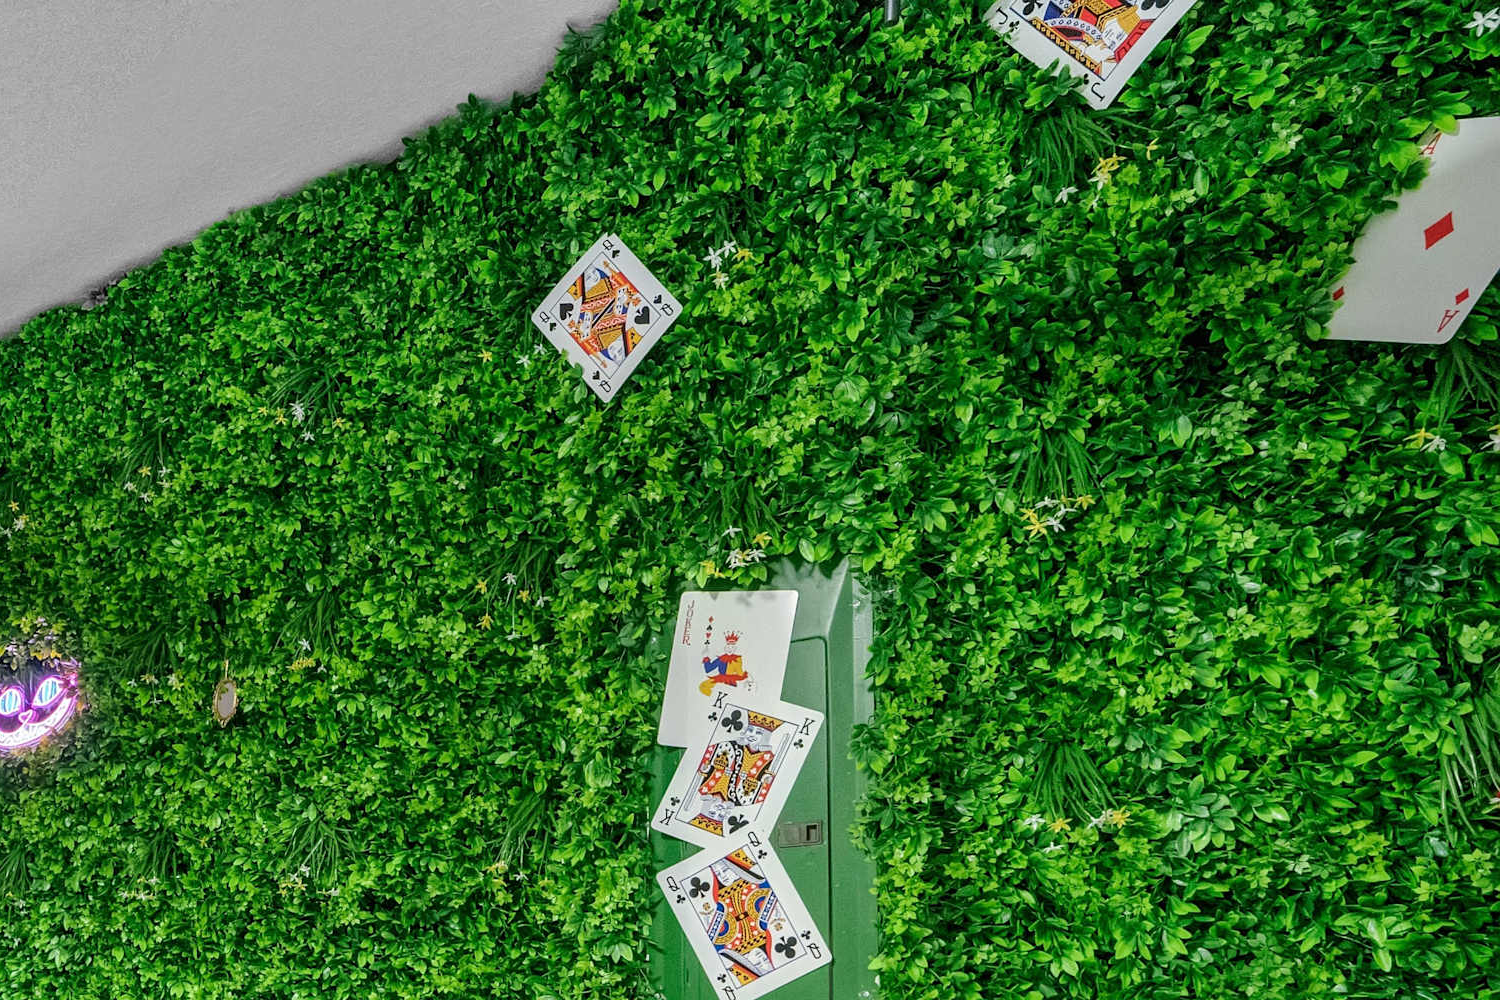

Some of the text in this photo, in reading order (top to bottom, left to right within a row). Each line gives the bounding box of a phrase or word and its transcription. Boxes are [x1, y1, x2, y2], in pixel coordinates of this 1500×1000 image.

[602, 239, 614, 251] Q
[539, 311, 551, 324] Q
[660, 303, 674, 317] Q
[1437, 309, 1460, 333] A
[598, 379, 612, 393] Q
[682, 600, 695, 646] JOKER
[713, 691, 728, 709] K
[799, 717, 815, 736] K
[659, 808, 675, 826] K
[747, 831, 762, 847] Q
[666, 876, 680, 892] Q
[807, 943, 821, 960] Q
